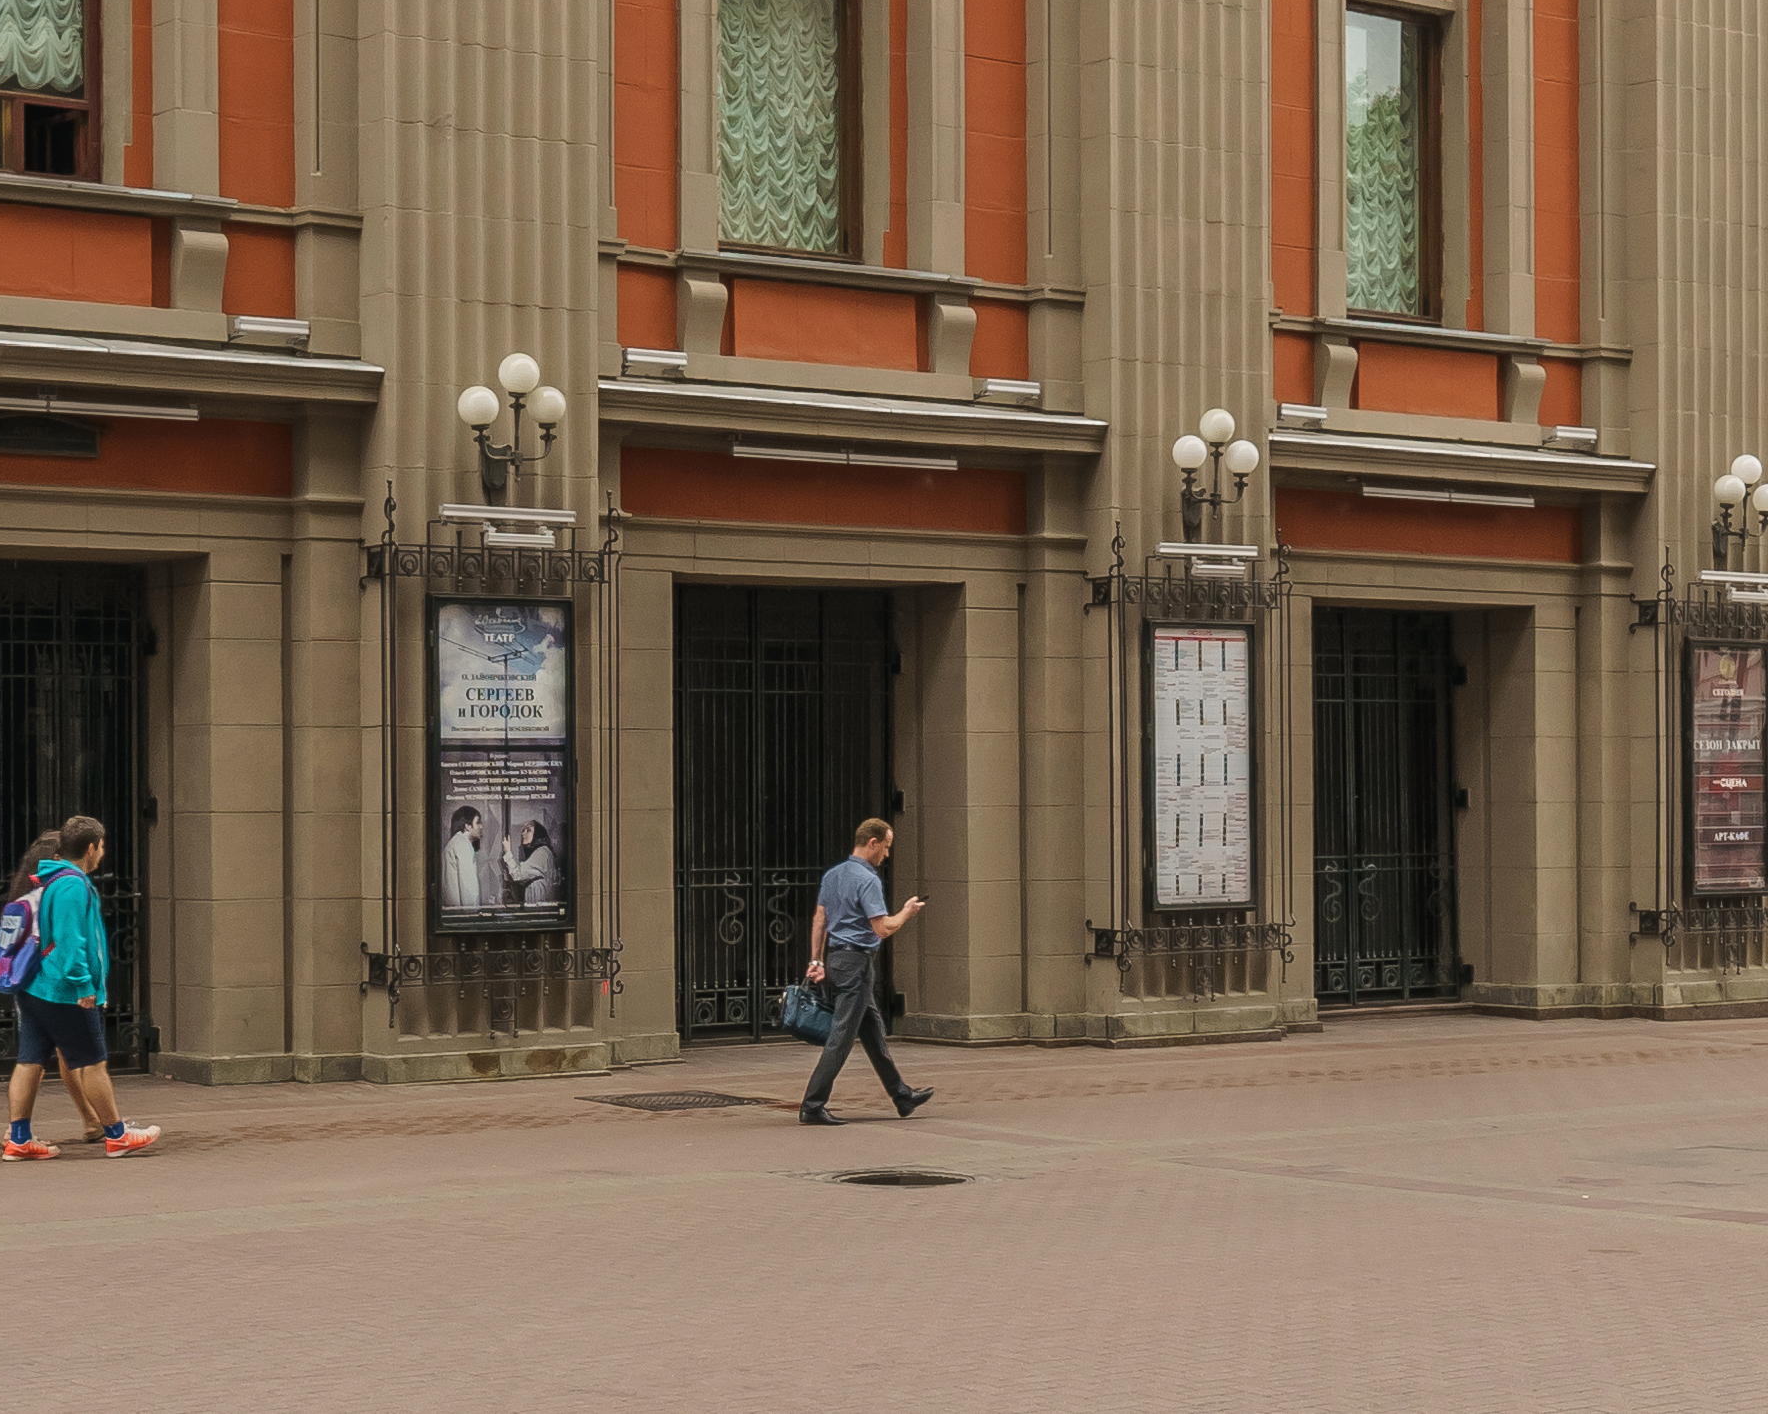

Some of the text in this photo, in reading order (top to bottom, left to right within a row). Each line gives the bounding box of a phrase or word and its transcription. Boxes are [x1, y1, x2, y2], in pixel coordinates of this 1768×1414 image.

[484, 633, 515, 643] ТЕАТР
[465, 687, 535, 702] СЕРГЕЕВ
[458, 704, 544, 719] и ГОРОДОК
[1694, 739, 1761, 750] СЕЗОН ЗАКРЫТ
[1720, 777, 1748, 789] СЦЕНА
[1713, 832, 1750, 842] АРТ-КАФЕ
